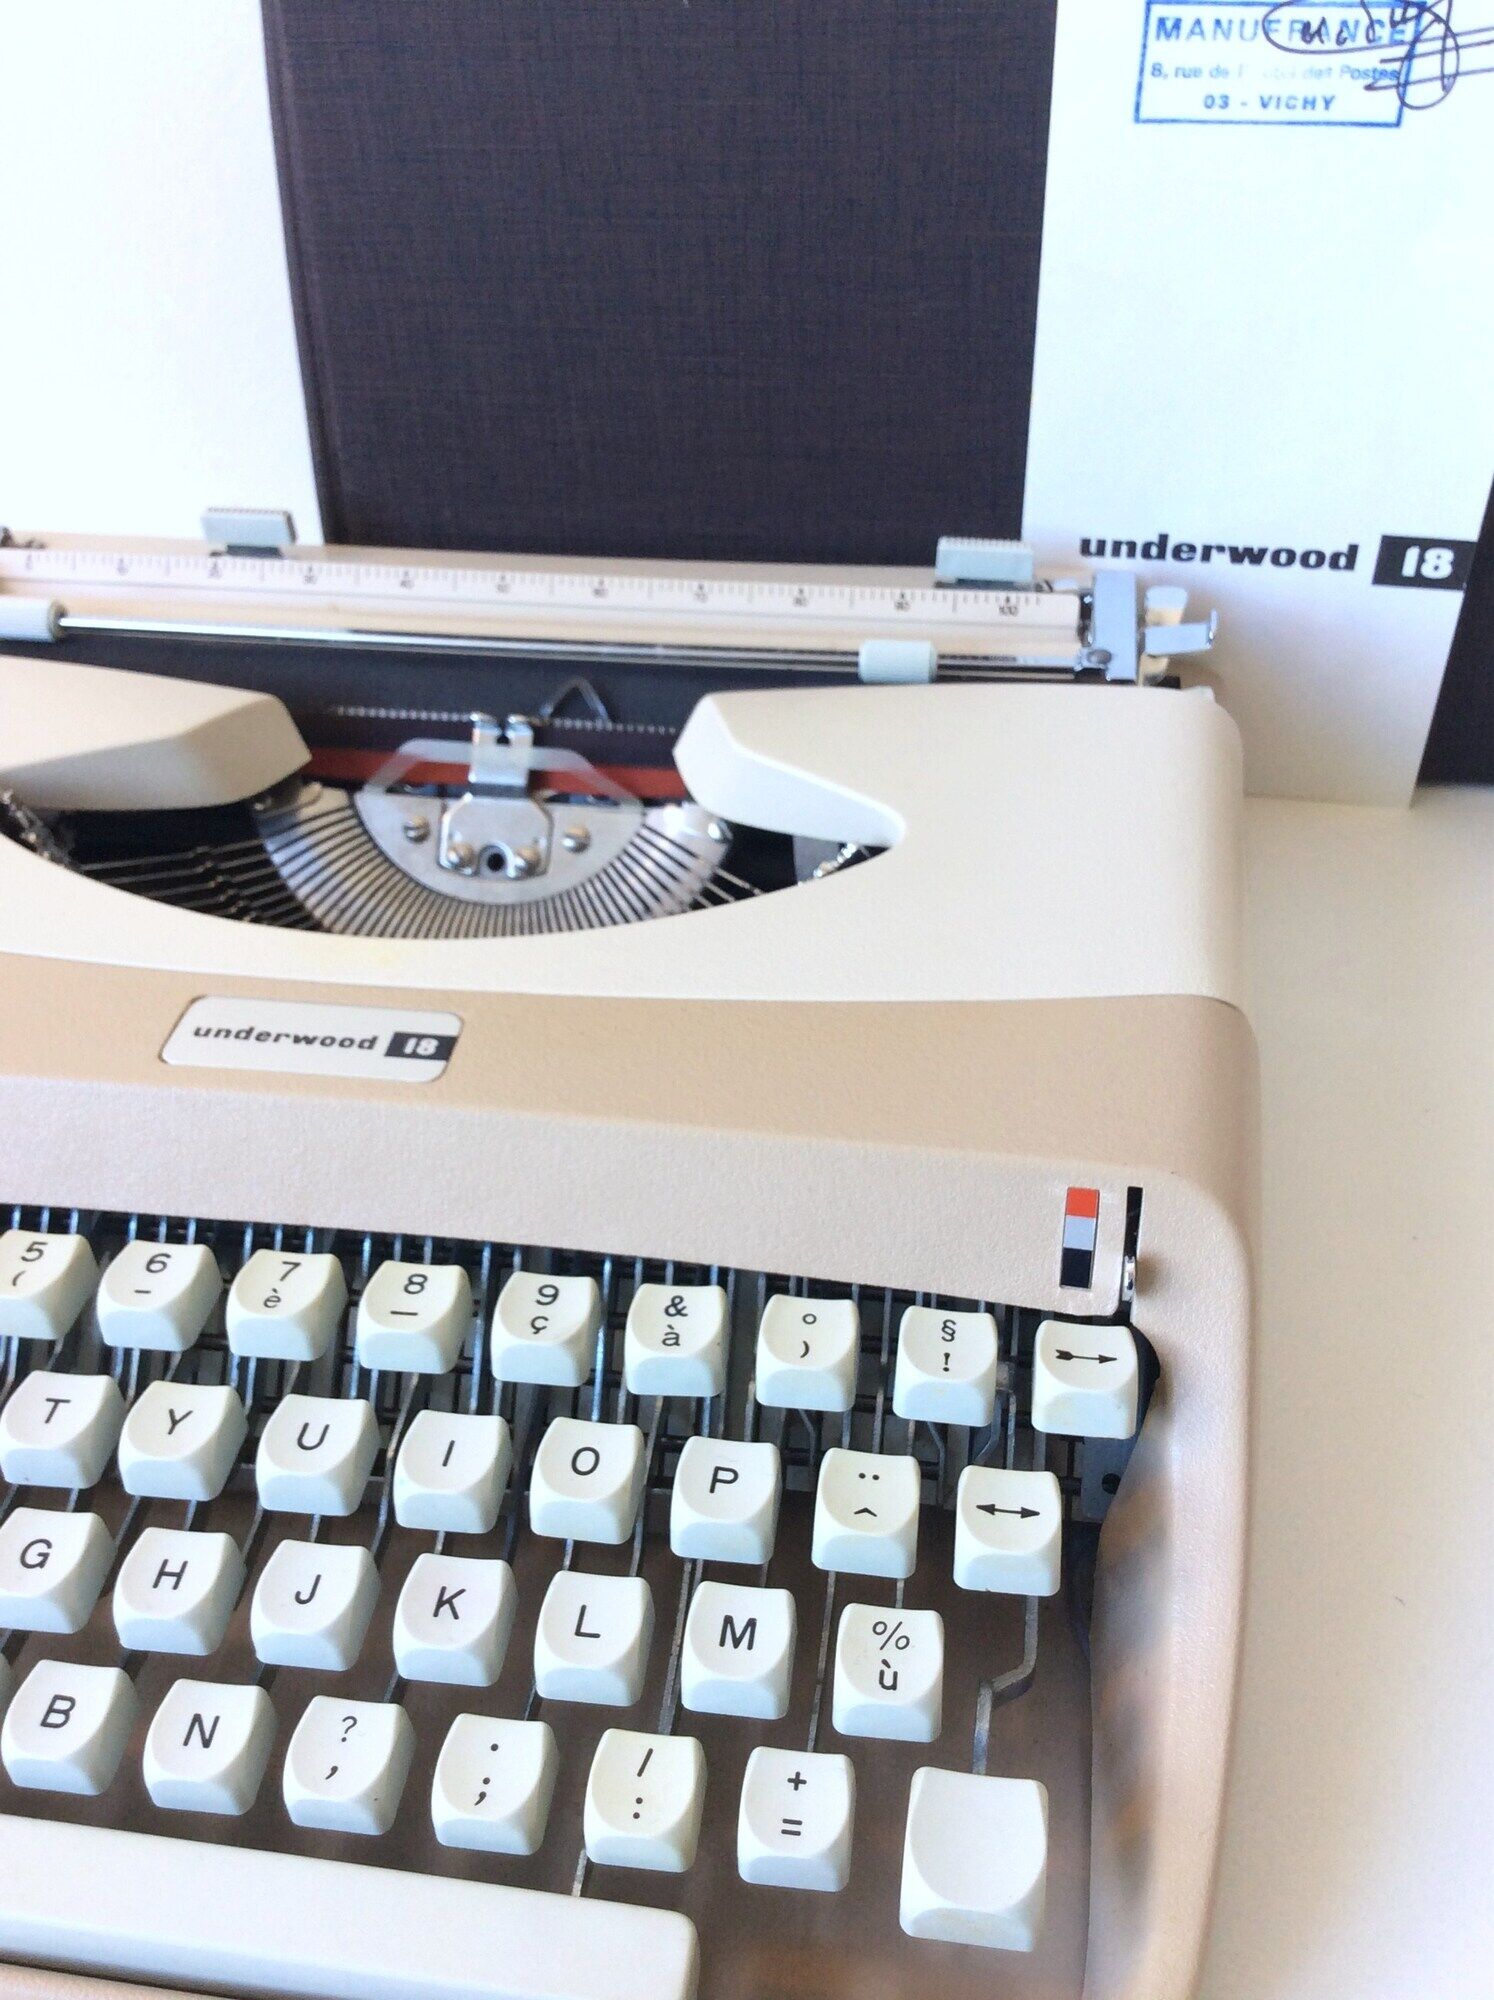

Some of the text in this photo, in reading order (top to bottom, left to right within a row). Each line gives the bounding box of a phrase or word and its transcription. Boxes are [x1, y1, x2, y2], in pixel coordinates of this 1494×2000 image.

[1154, 16, 1407, 46] MANUFRANCE
[1174, 66, 1203, 79] rue
[1208, 64, 1230, 79] de
[1203, 94, 1230, 110] 03
[1259, 95, 1336, 111] VICHY
[1078, 533, 1456, 580] underwood 18
[193, 1026, 439, 1057] underwood 18
[20, 1240, 48, 1263] 5
[145, 1252, 172, 1274] 6
[279, 1260, 302, 1282] 7
[403, 1273, 428, 1295] 8
[262, 1287, 282, 1309] è
[534, 1284, 560, 1306] 9
[663, 1294, 689, 1318] &
[530, 1315, 549, 1335] ç
[661, 1324, 681, 1347] à
[44, 1397, 71, 1425] T
[167, 1408, 194, 1436] Y
[296, 1422, 330, 1451] U
[441, 1439, 456, 1468] I
[570, 1446, 601, 1477] O
[709, 1465, 739, 1494] P
[19, 1538, 53, 1570] G
[152, 1558, 189, 1591] H
[294, 1574, 322, 1605] J
[432, 1585, 467, 1621] K
[574, 1604, 601, 1639] L
[718, 1614, 758, 1651] M
[872, 1620, 911, 1651] %
[878, 1658, 899, 1692] ù
[39, 1694, 76, 1729] B
[182, 1712, 221, 1749] N
[340, 1715, 358, 1743] ?
